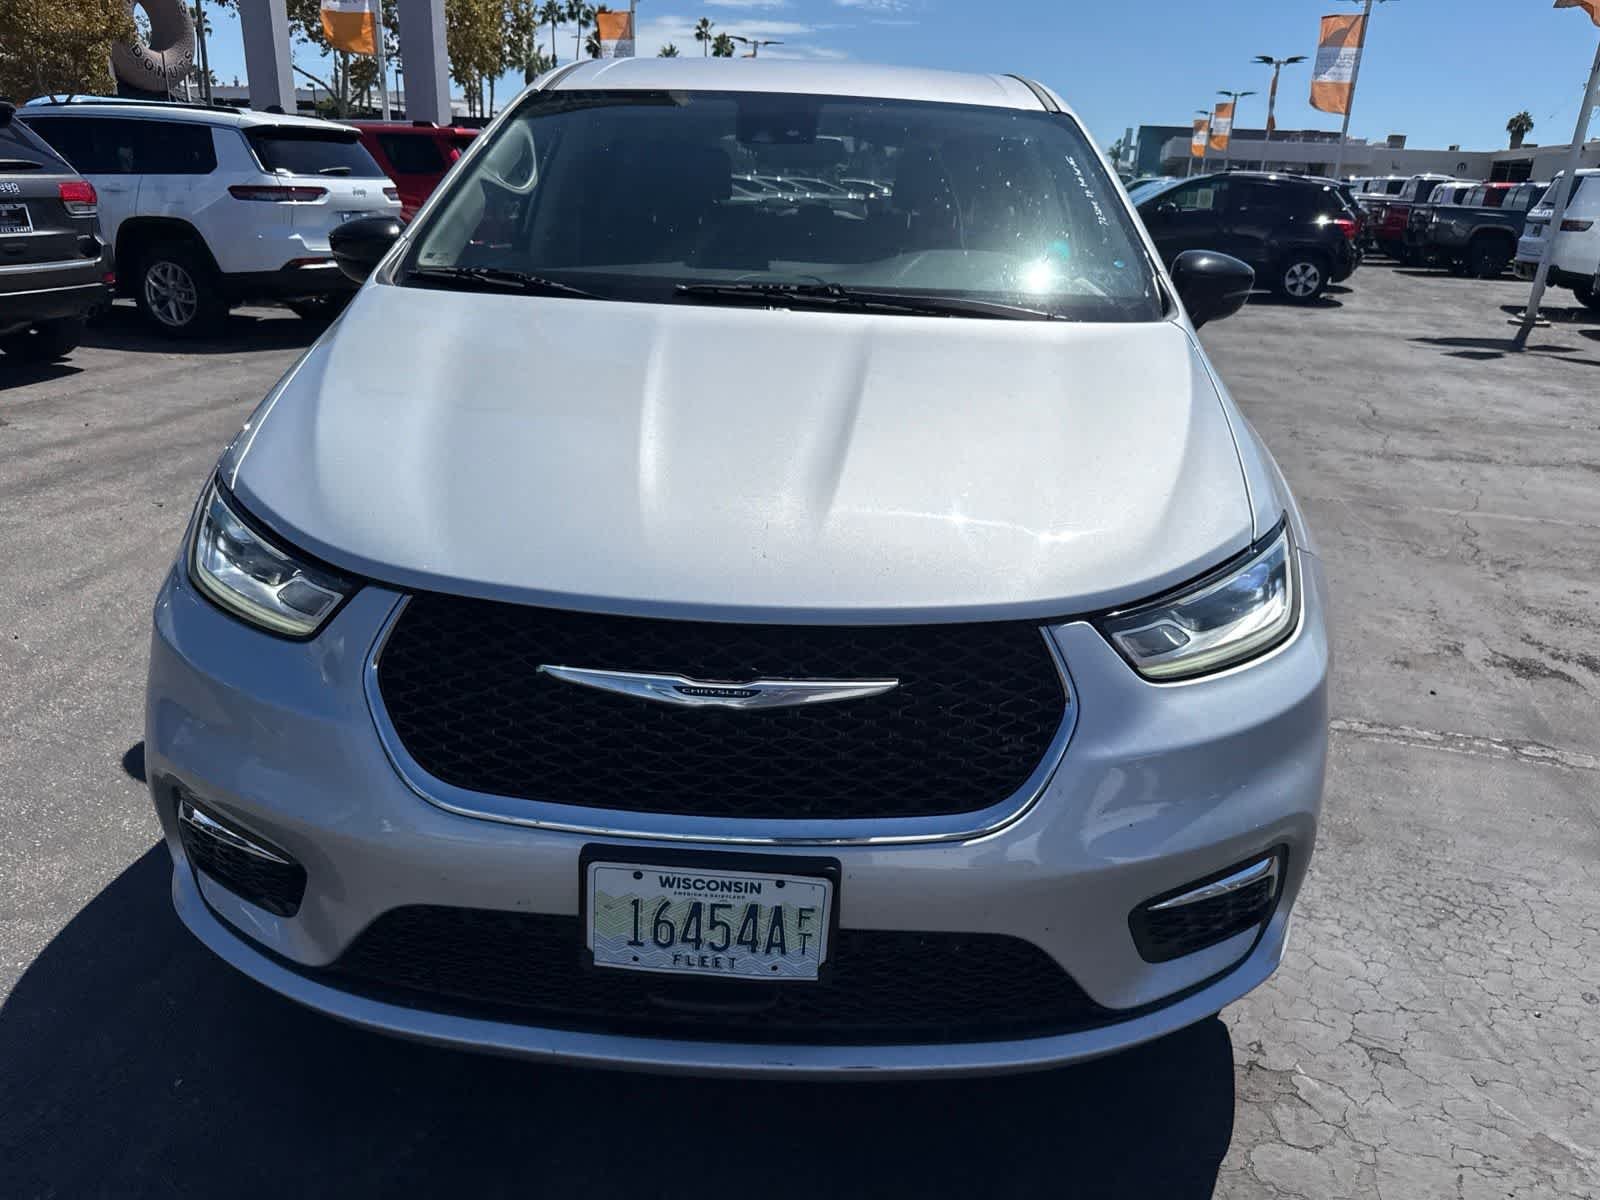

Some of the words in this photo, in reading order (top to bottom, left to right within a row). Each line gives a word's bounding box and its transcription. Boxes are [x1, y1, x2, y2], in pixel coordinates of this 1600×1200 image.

[131, 43, 193, 79] DONUTS
[681, 687, 750, 697] CHRYSLER
[659, 876, 762, 895] WISCONSIN
[627, 898, 787, 956] 16454A
[673, 954, 738, 969] FLEET
